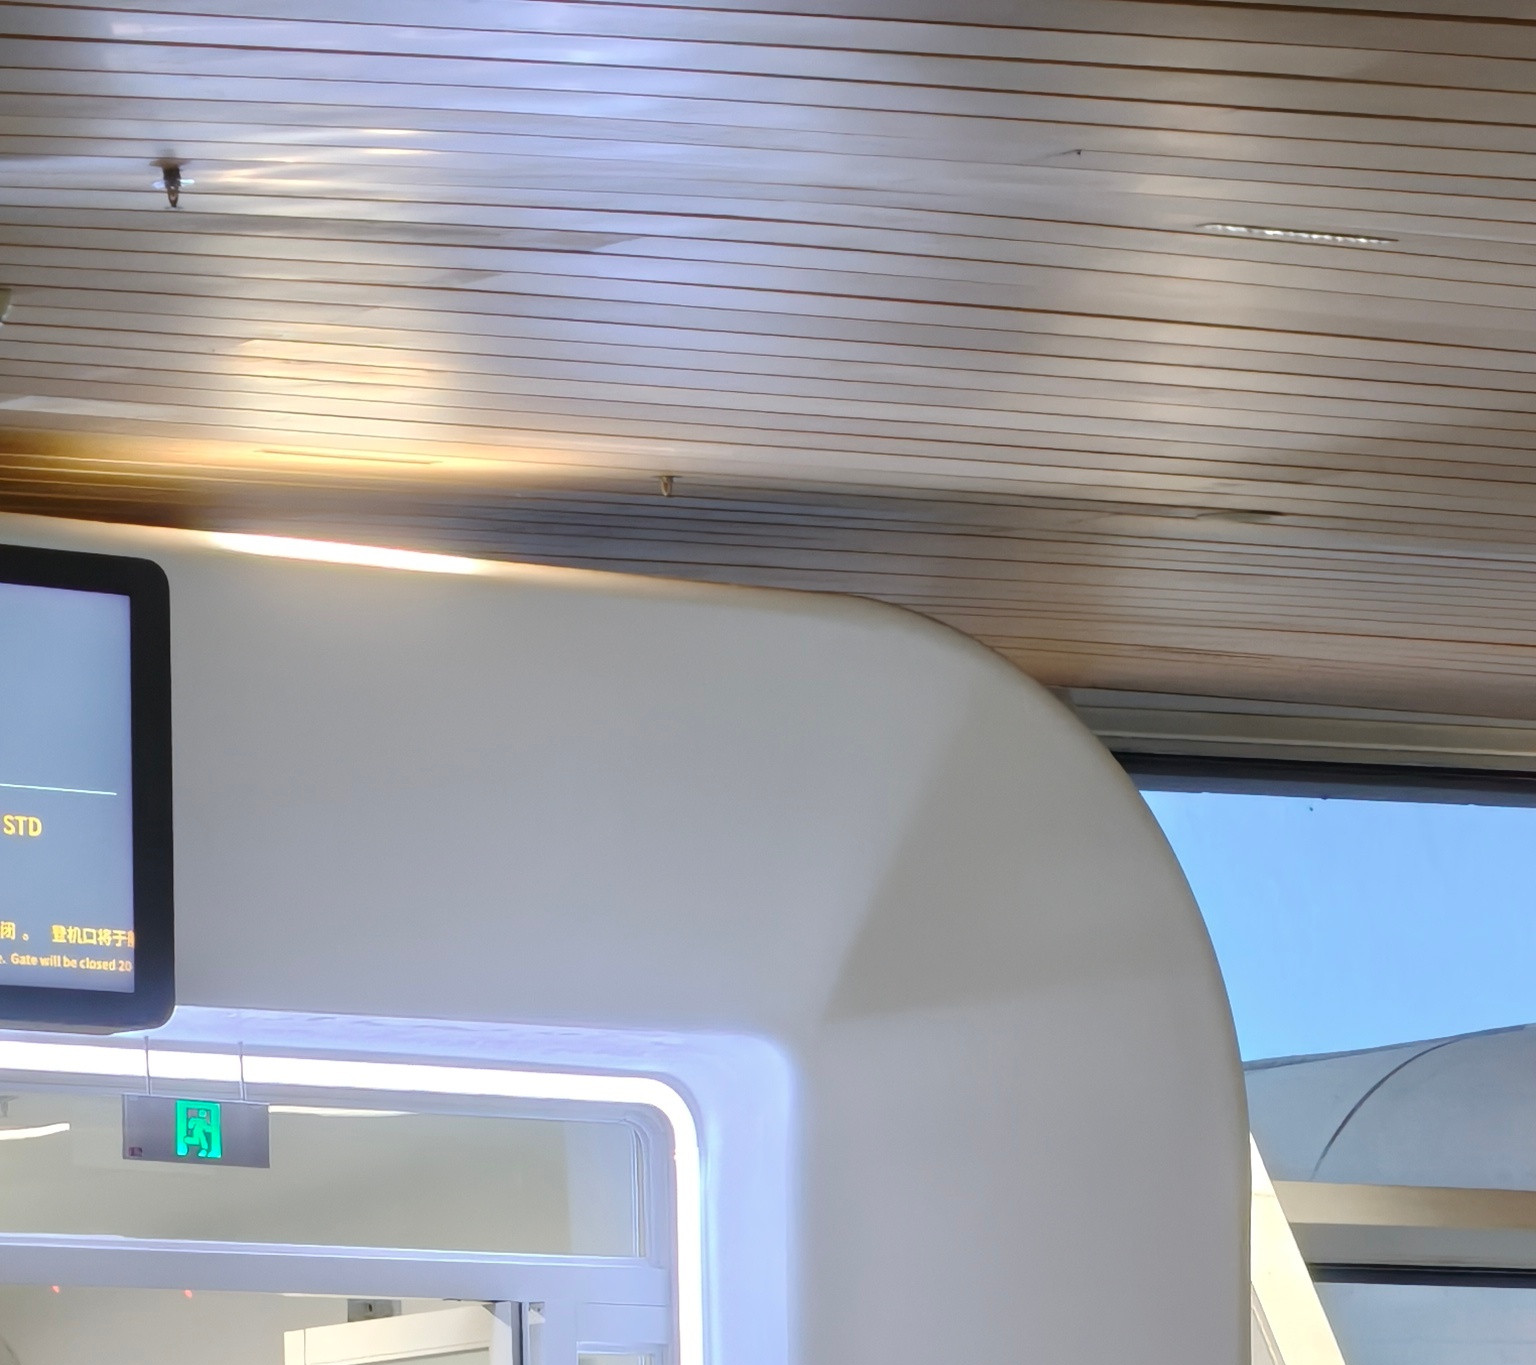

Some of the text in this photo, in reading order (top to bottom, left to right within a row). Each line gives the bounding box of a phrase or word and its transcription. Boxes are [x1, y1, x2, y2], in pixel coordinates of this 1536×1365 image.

[3, 814, 43, 837] STD
[10, 953, 38, 966] Gate
[39, 955, 61, 967] will
[63, 956, 77, 968] be
[79, 958, 116, 971] closed
